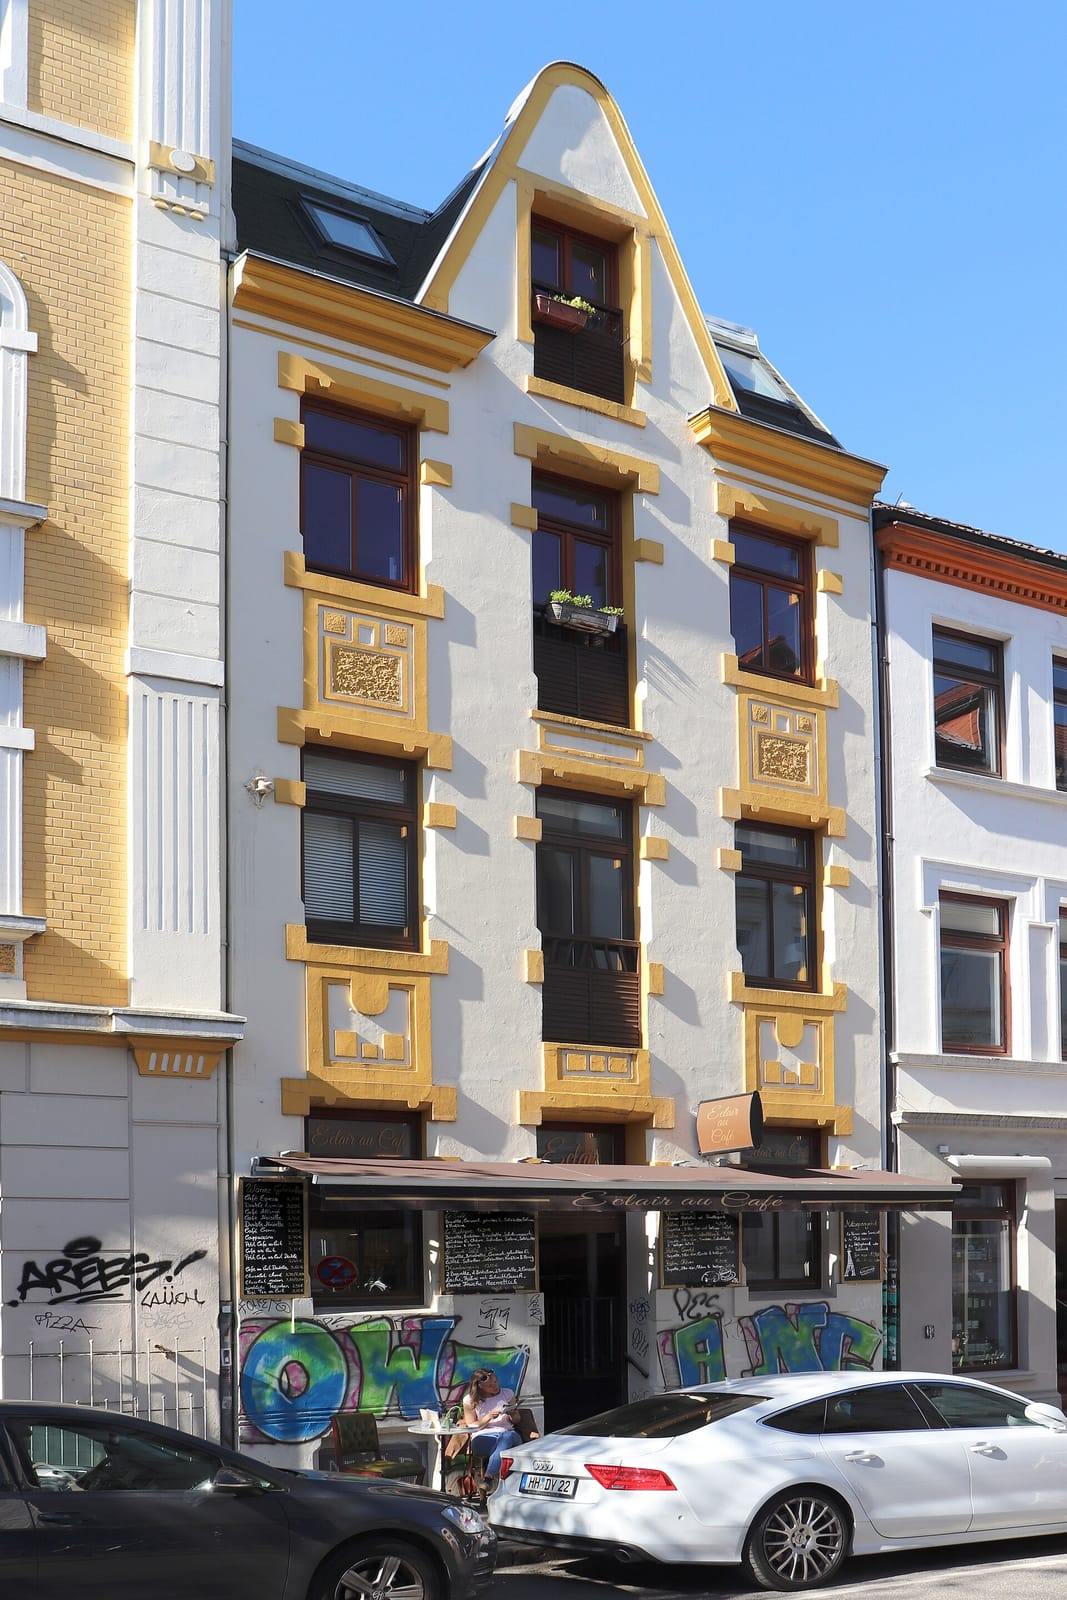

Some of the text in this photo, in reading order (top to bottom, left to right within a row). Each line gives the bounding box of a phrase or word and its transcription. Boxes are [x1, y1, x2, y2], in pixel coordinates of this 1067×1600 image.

[707, 1105, 739, 1120] Eclair
[717, 1118, 728, 1127] au
[311, 1124, 355, 1146] Eclair
[359, 1134, 375, 1146] au
[572, 1191, 784, 1211] Eclair au Café
[527, 1476, 571, 1493] HH DY 22
